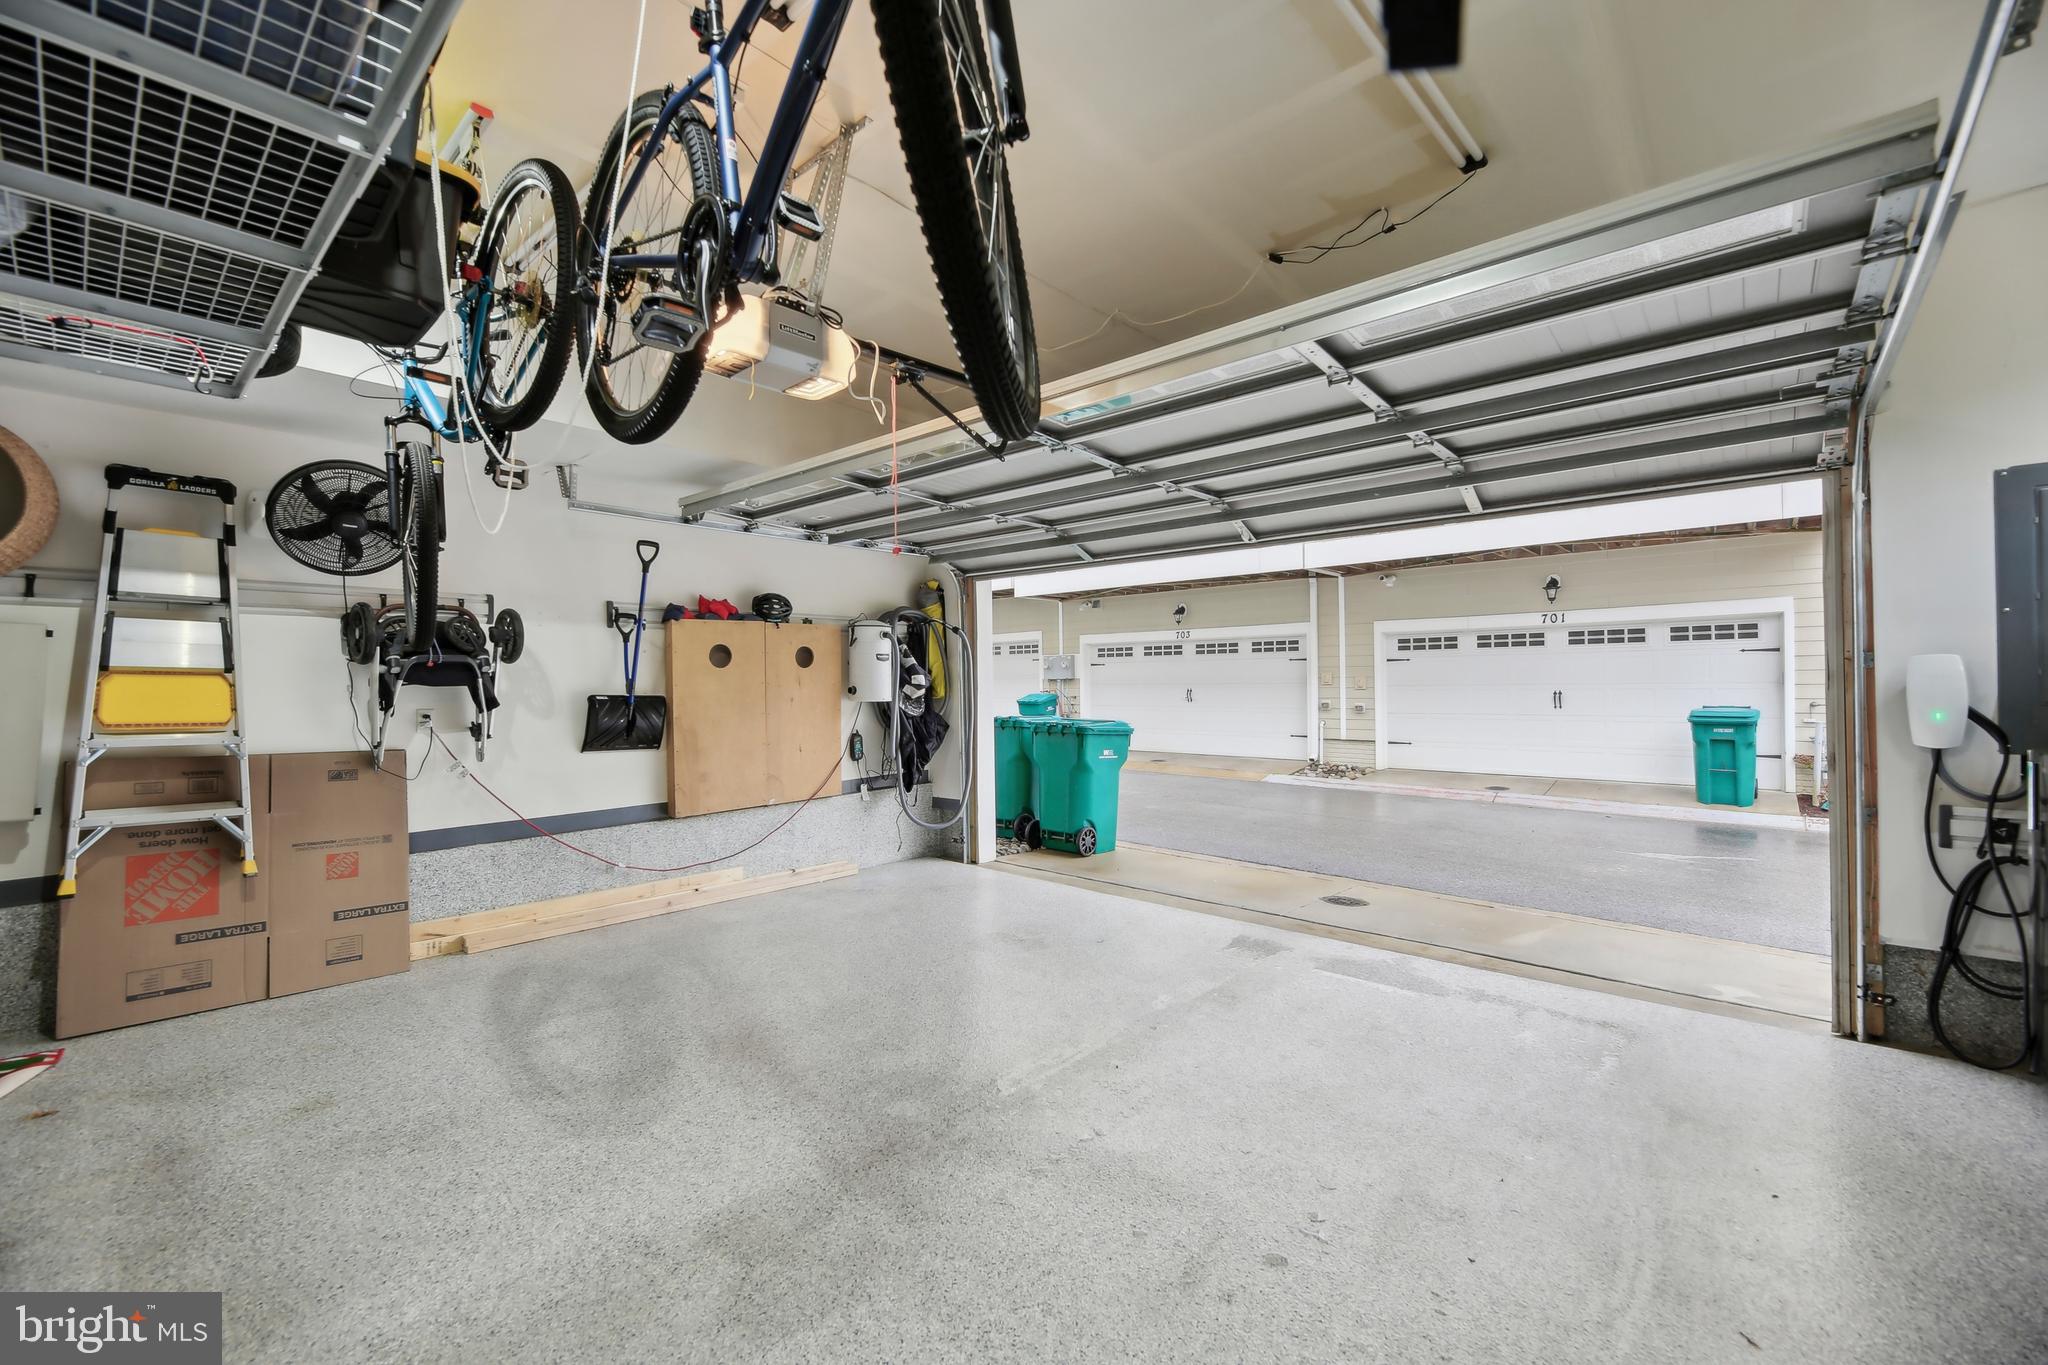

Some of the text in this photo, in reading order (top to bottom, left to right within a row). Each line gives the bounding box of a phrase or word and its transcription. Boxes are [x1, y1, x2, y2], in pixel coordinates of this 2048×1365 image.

[129, 477, 217, 495] GORILLA LADDERS
[1541, 612, 1565, 624] 701
[1175, 630, 1191, 640] 703
[165, 827, 198, 836] more
[138, 836, 209, 848] How doers
[126, 851, 183, 900] DEPOT
[126, 849, 219, 924] HOME
[172, 882, 209, 912] THE
[337, 903, 406, 920] EXTRA LARGE
[180, 924, 263, 943] EXTRA LARGE
